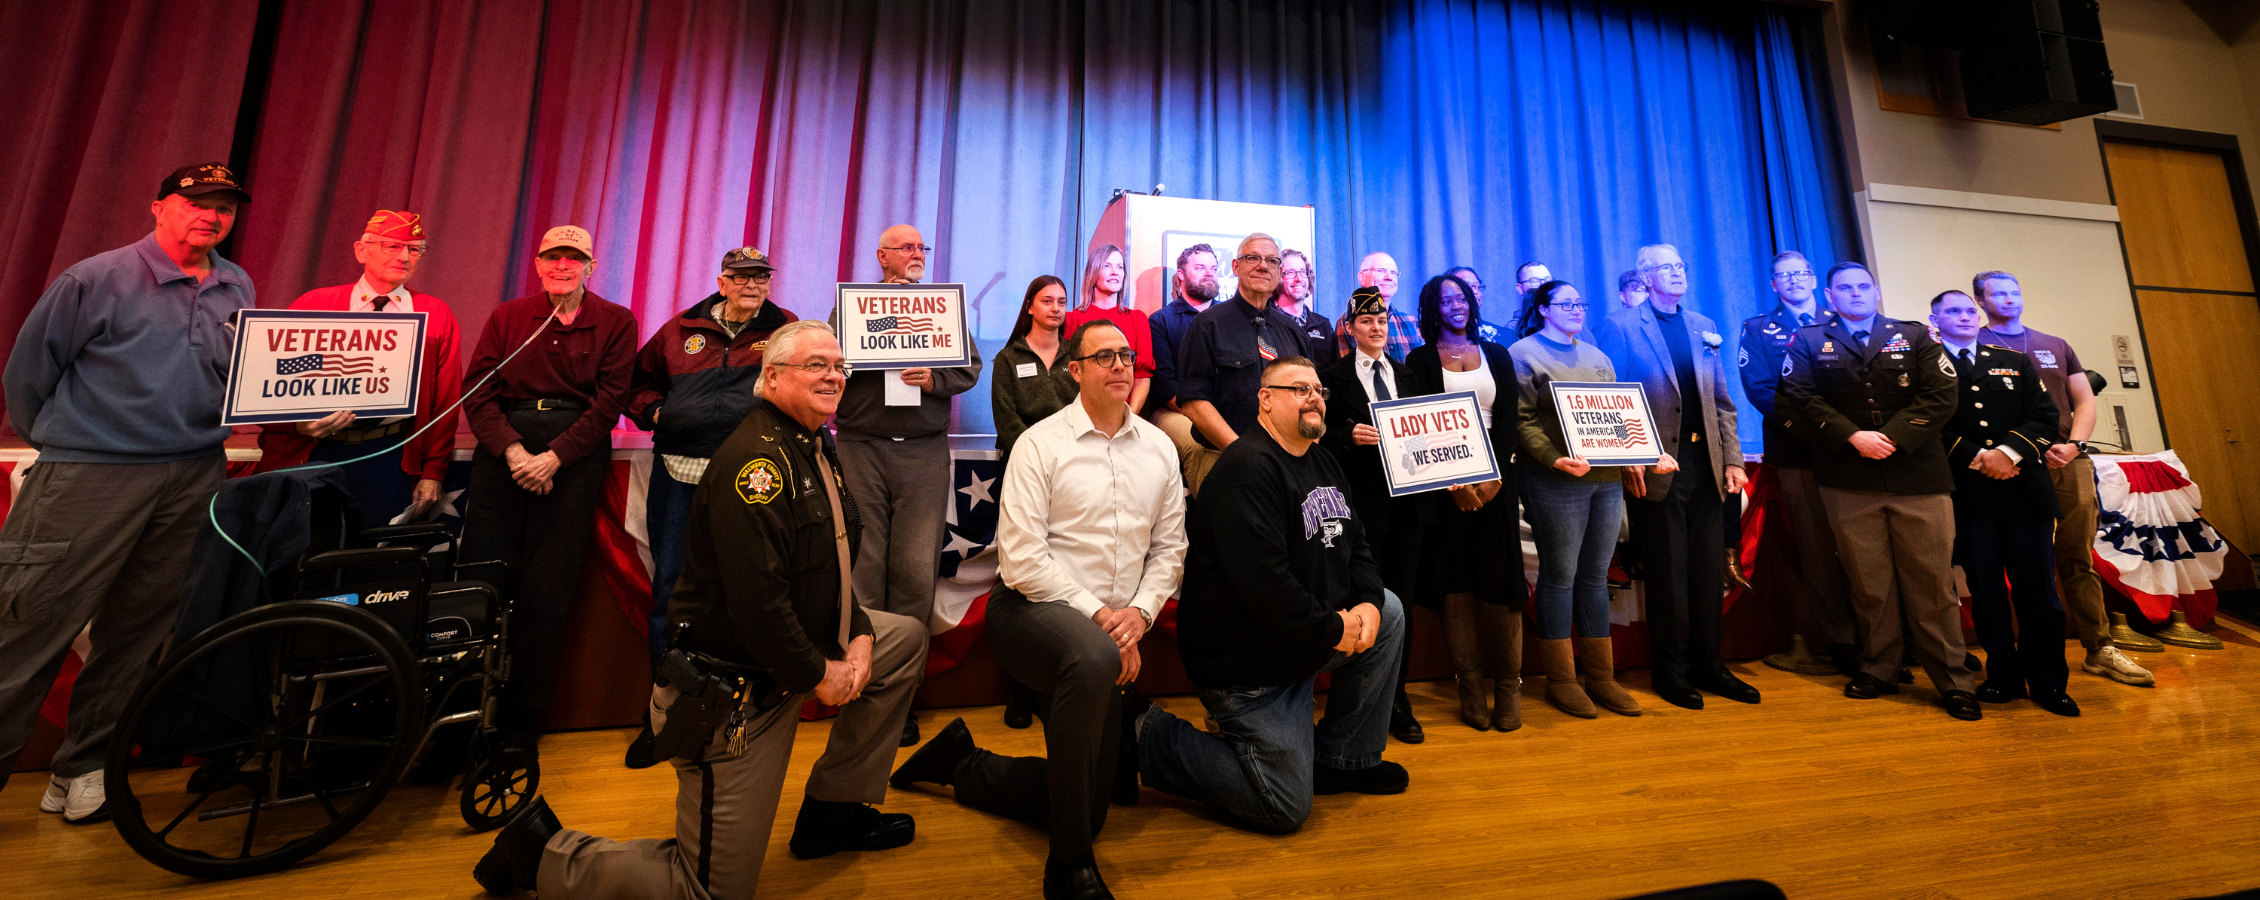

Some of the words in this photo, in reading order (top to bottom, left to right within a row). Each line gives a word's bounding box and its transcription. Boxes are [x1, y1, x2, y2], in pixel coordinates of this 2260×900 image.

[203, 177, 234, 185] VETERAN
[857, 296, 947, 314] VETERANS
[267, 328, 398, 352] VETERANS
[860, 335, 897, 350] LOOK
[901, 334, 929, 349] LIKE
[932, 334, 952, 348] ME
[262, 378, 317, 398] LOOK
[321, 377, 362, 396] LIKE
[365, 376, 390, 394] US
[1567, 394, 1584, 409] 1.6
[1584, 395, 1634, 410] MILLION
[1390, 413, 1428, 438] LADY
[1430, 408, 1470, 432] VETS
[1572, 411, 1623, 424] VETERANS
[1577, 427, 1585, 435] IN
[1586, 427, 1615, 436] AMERICA
[1581, 438, 1596, 448] ARE
[1596, 438, 1624, 448] WOMEN
[1412, 449, 1431, 466] WE
[1431, 444, 1473, 463] SERVED.
[766, 464, 780, 481] COUNTY
[749, 493, 769, 501] SHERIFF
[364, 589, 412, 605] drive
[430, 629, 458, 638] COMFORT
